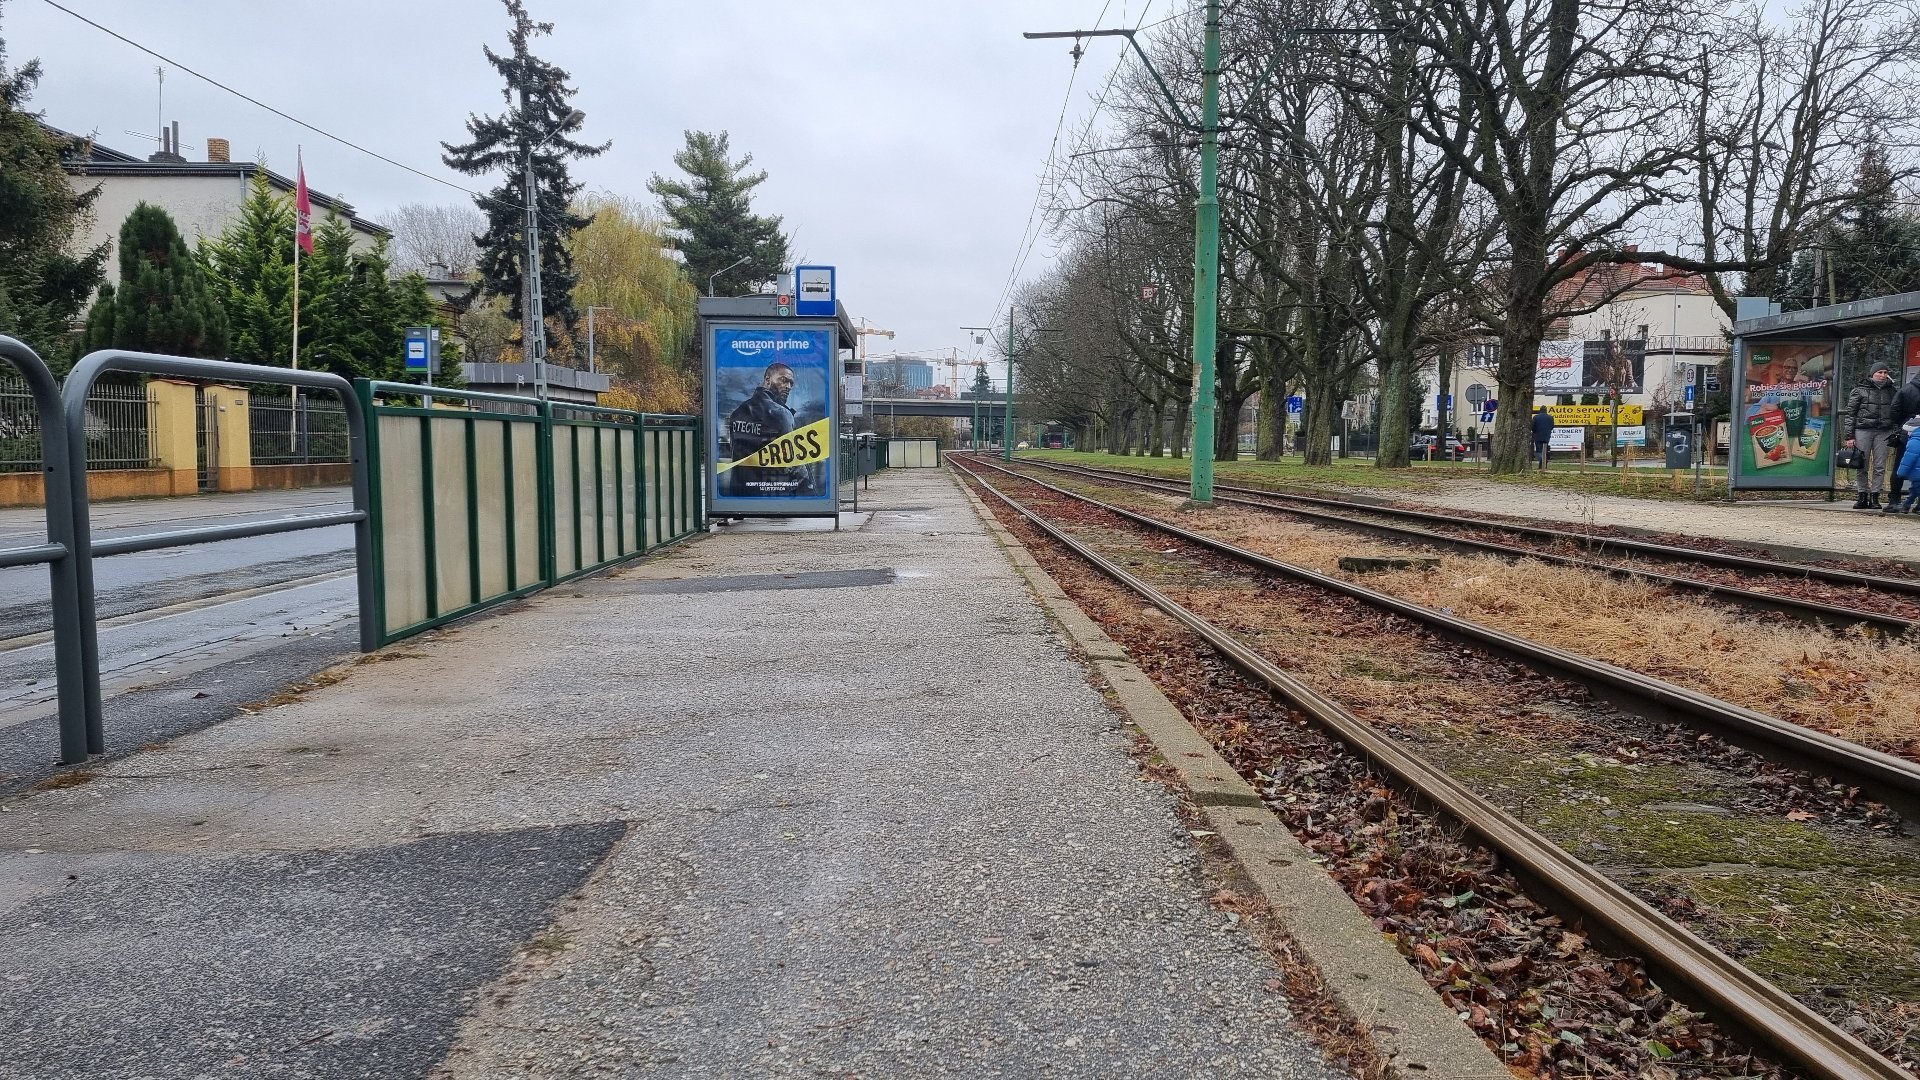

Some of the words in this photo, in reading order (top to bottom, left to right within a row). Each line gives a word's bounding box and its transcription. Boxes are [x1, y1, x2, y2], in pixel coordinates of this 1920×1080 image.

[731, 340, 774, 350] amazon
[777, 338, 809, 351] prime
[1750, 383, 1778, 392] Robisz
[1780, 381, 1792, 391] się
[1793, 379, 1828, 391] głodny?
[1548, 406, 1574, 414] Auto
[1576, 406, 1610, 414] serwis
[758, 429, 821, 466] CROSS
